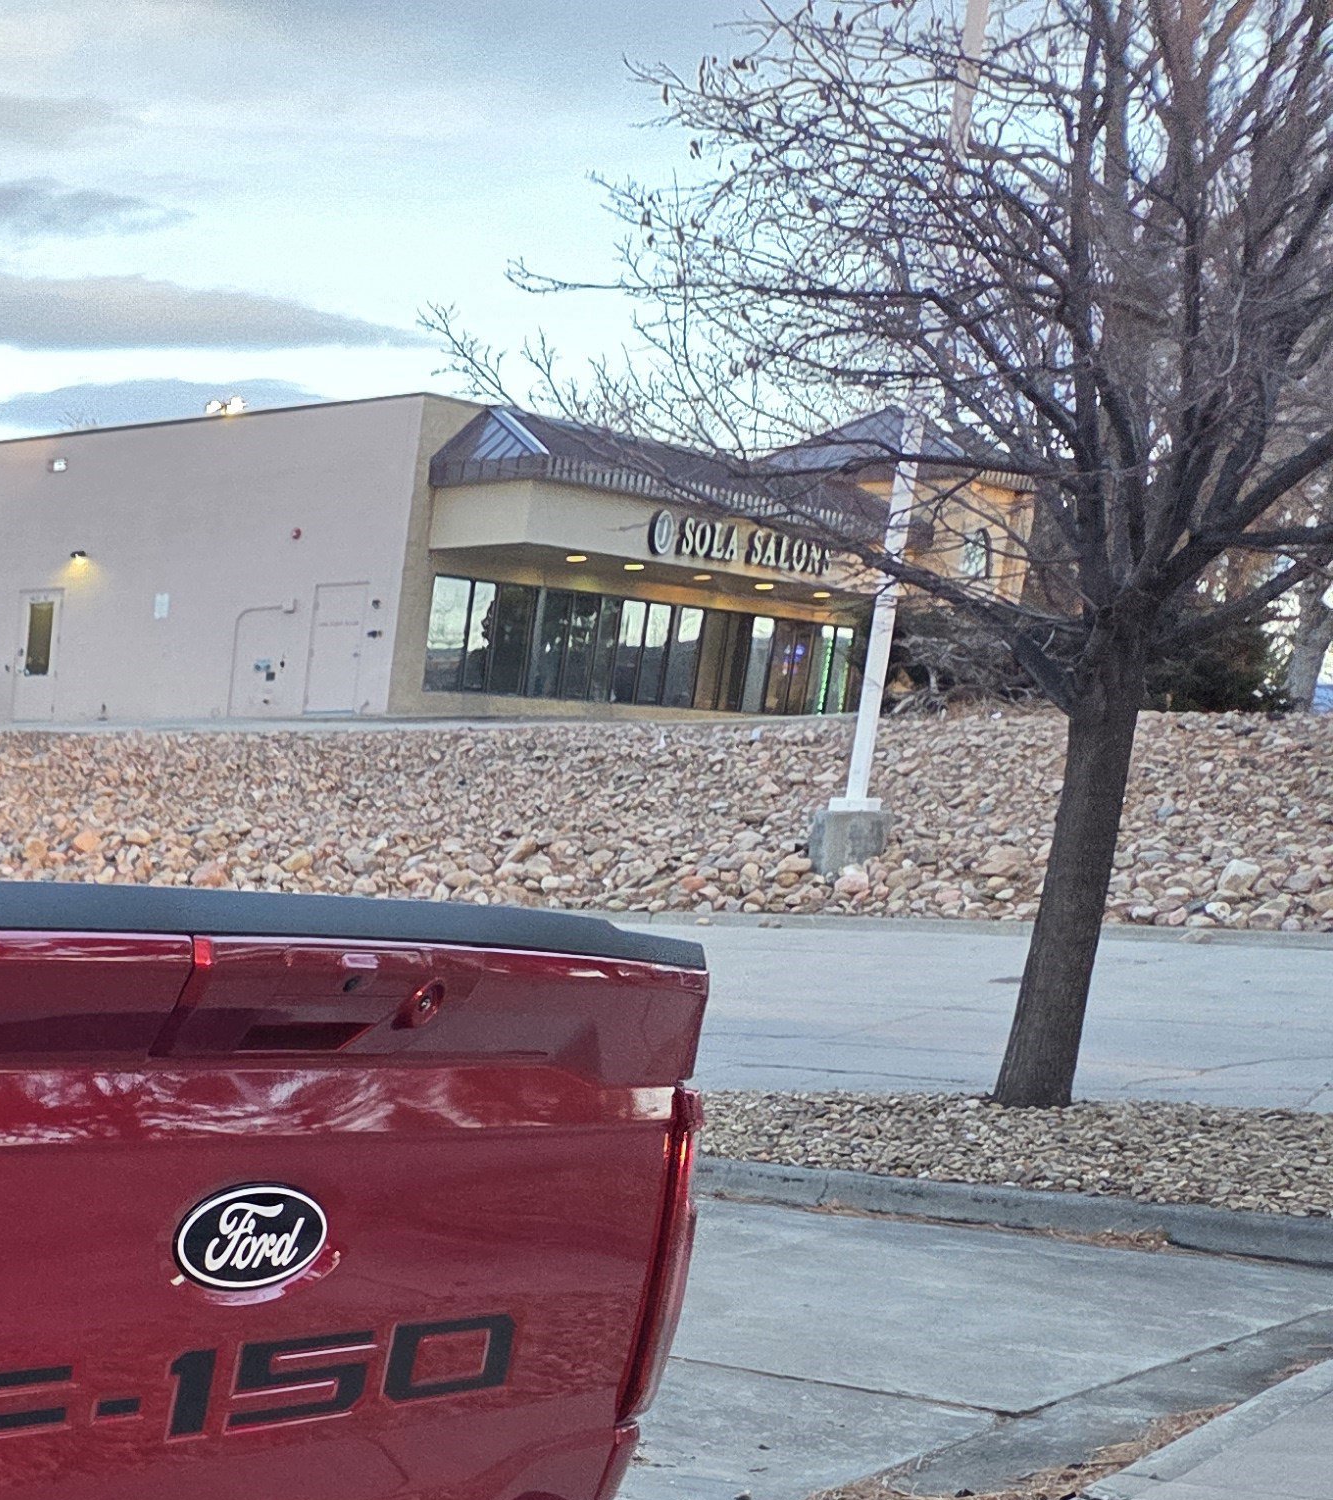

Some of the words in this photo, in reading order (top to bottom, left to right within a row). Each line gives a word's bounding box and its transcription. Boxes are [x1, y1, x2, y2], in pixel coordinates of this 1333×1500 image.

[680, 516, 738, 560] SOLA
[750, 529, 833, 576] SALONS
[204, 1201, 306, 1272] Ford
